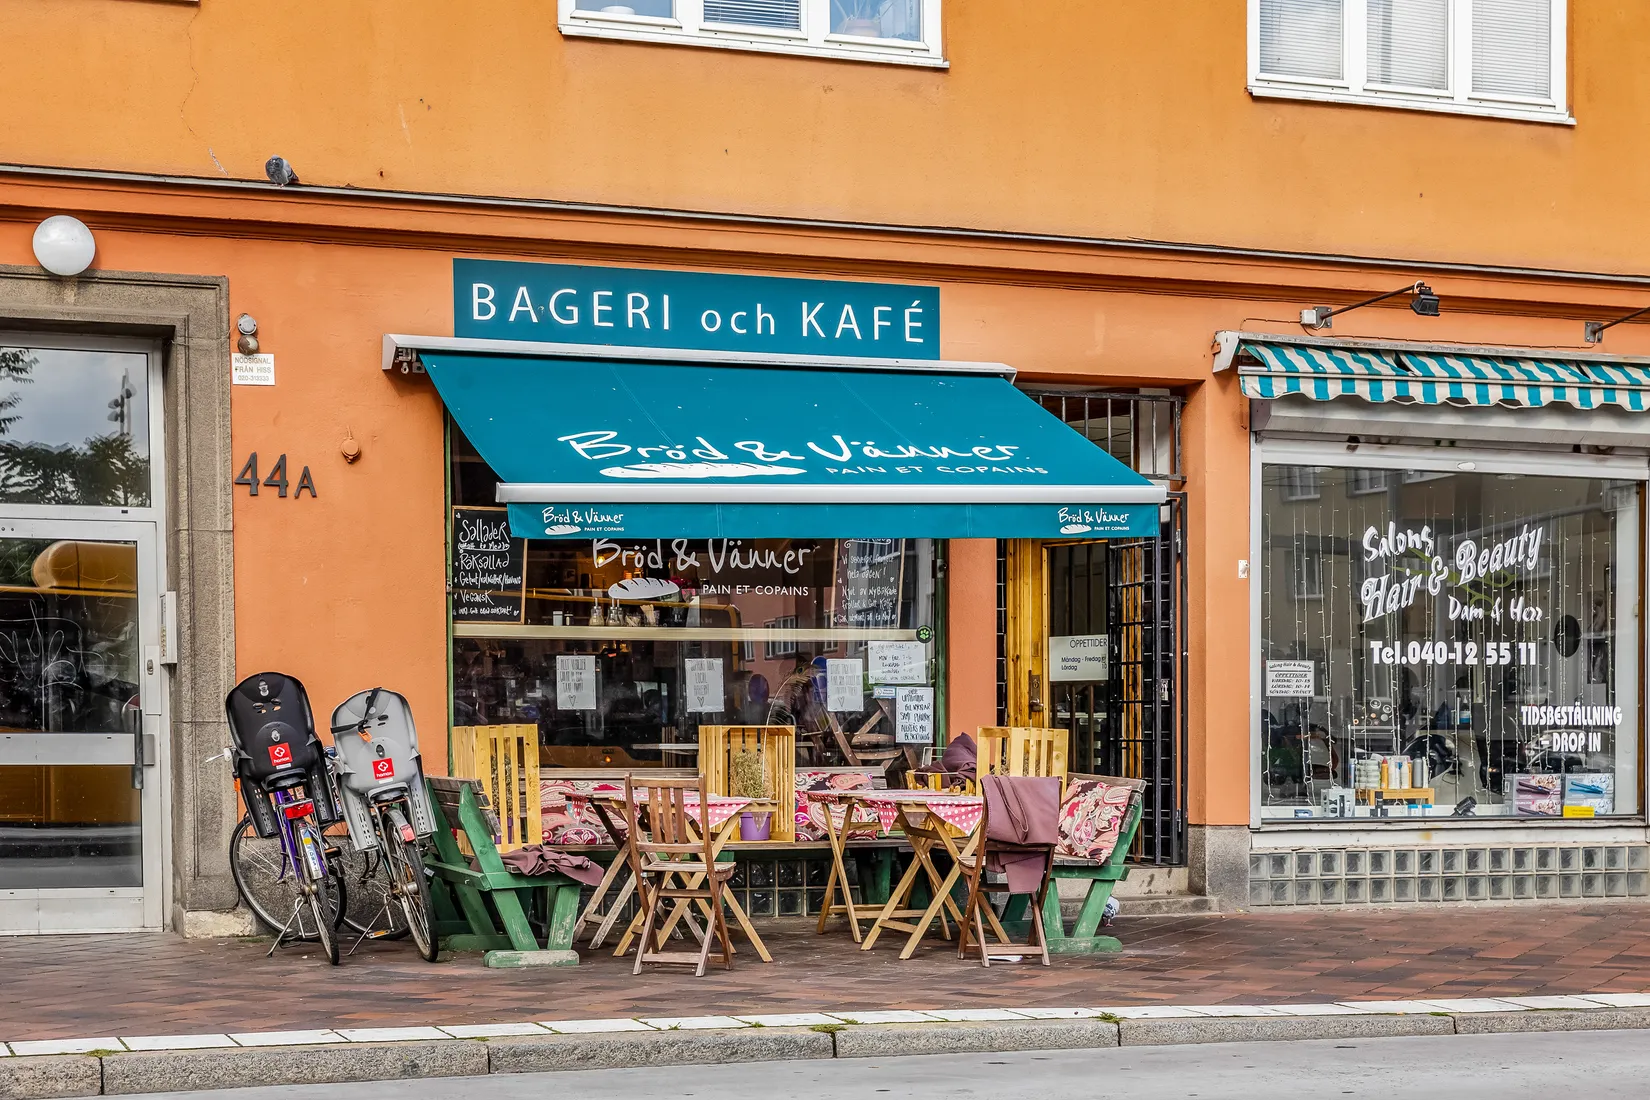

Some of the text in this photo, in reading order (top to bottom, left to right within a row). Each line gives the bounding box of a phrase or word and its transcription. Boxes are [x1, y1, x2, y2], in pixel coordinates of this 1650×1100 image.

[472, 282, 925, 343] BAGERI och KAFÉ
[256, 366, 272, 374] HISS
[557, 430, 1020, 462] Bröd & Vänner
[825, 465, 1049, 475] PAIN ET COPAINS
[541, 506, 624, 524] Bröd & Vänner
[1057, 506, 1130, 524] Bröd & Vänner
[592, 538, 811, 574] Bröd & Vänner
[1360, 523, 1543, 623] Hair & Beauty
[702, 584, 809, 597] PAIN ET COPAINS
[1448, 594, 1484, 622] Dam
[1069, 637, 1108, 648] ÖPPETTIDER
[1485, 641, 1512, 666] 55
[1518, 641, 1537, 666] 11
[1520, 702, 1623, 727] TIDSBESTÄLLNING
[1552, 731, 1587, 752] DROP
[1587, 732, 1602, 752] IN
